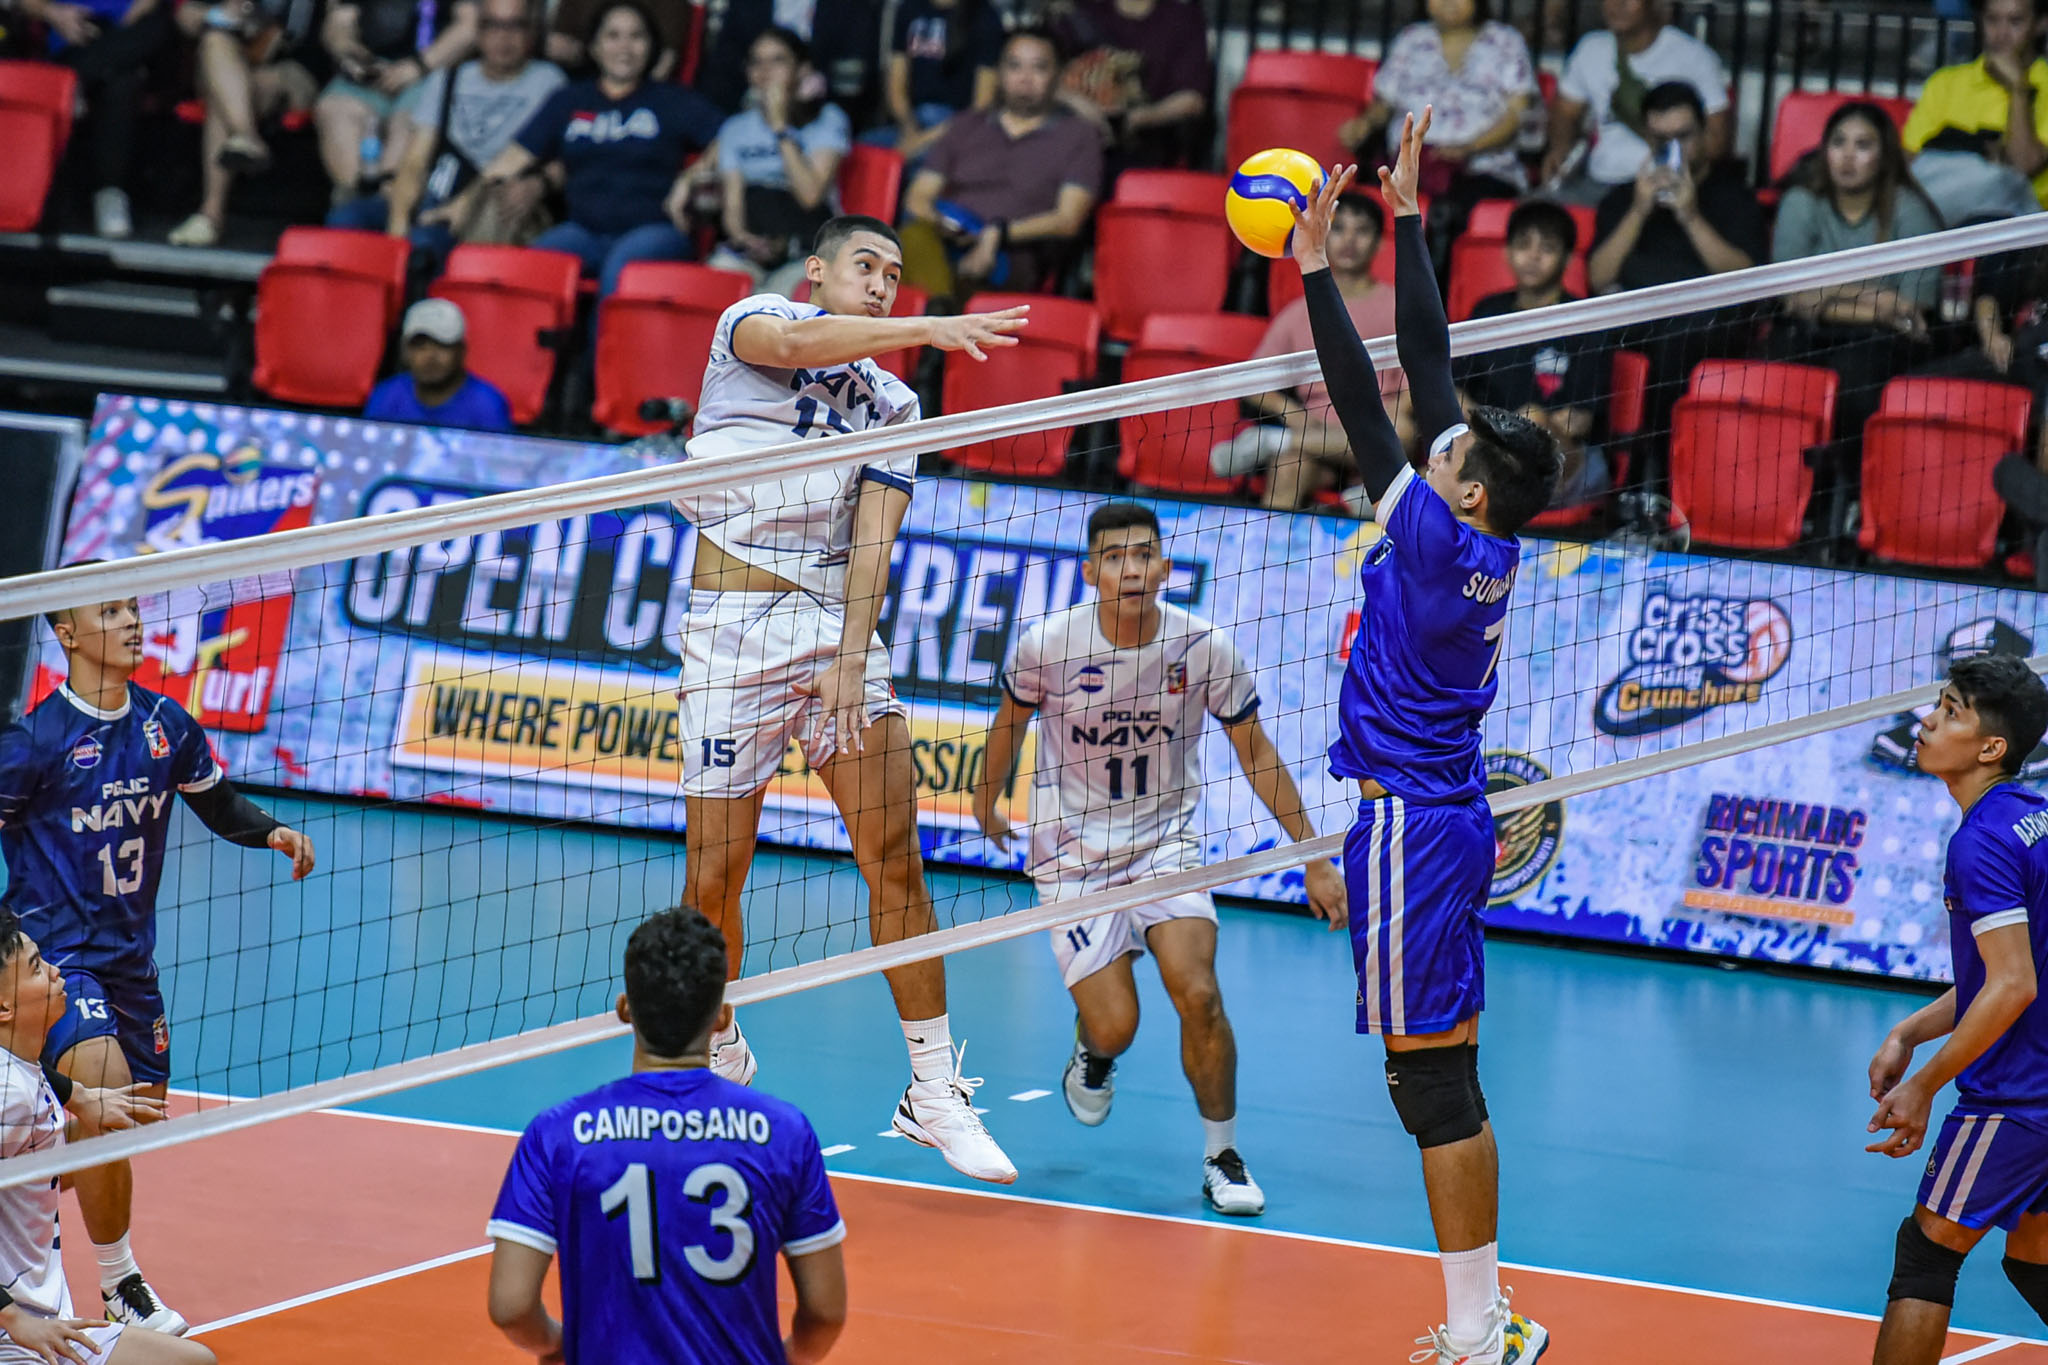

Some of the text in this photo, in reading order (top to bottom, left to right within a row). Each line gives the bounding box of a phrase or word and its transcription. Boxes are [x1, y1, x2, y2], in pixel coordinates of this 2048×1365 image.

[432, 683, 567, 749] WHERE
[572, 699, 684, 762] POWE
[1071, 724, 1175, 747] NAVY
[702, 738, 736, 768] 15
[1105, 754, 1149, 800] 11
[71, 790, 168, 833] NAVY
[1704, 792, 1867, 848] RICHMARC
[97, 835, 146, 897] 13
[1696, 835, 1859, 905] SPORTS
[1067, 924, 1091, 952] 11
[75, 997, 108, 1020] 13
[572, 1105, 771, 1145] CAMPOSANO
[600, 1162, 756, 1284] 13
